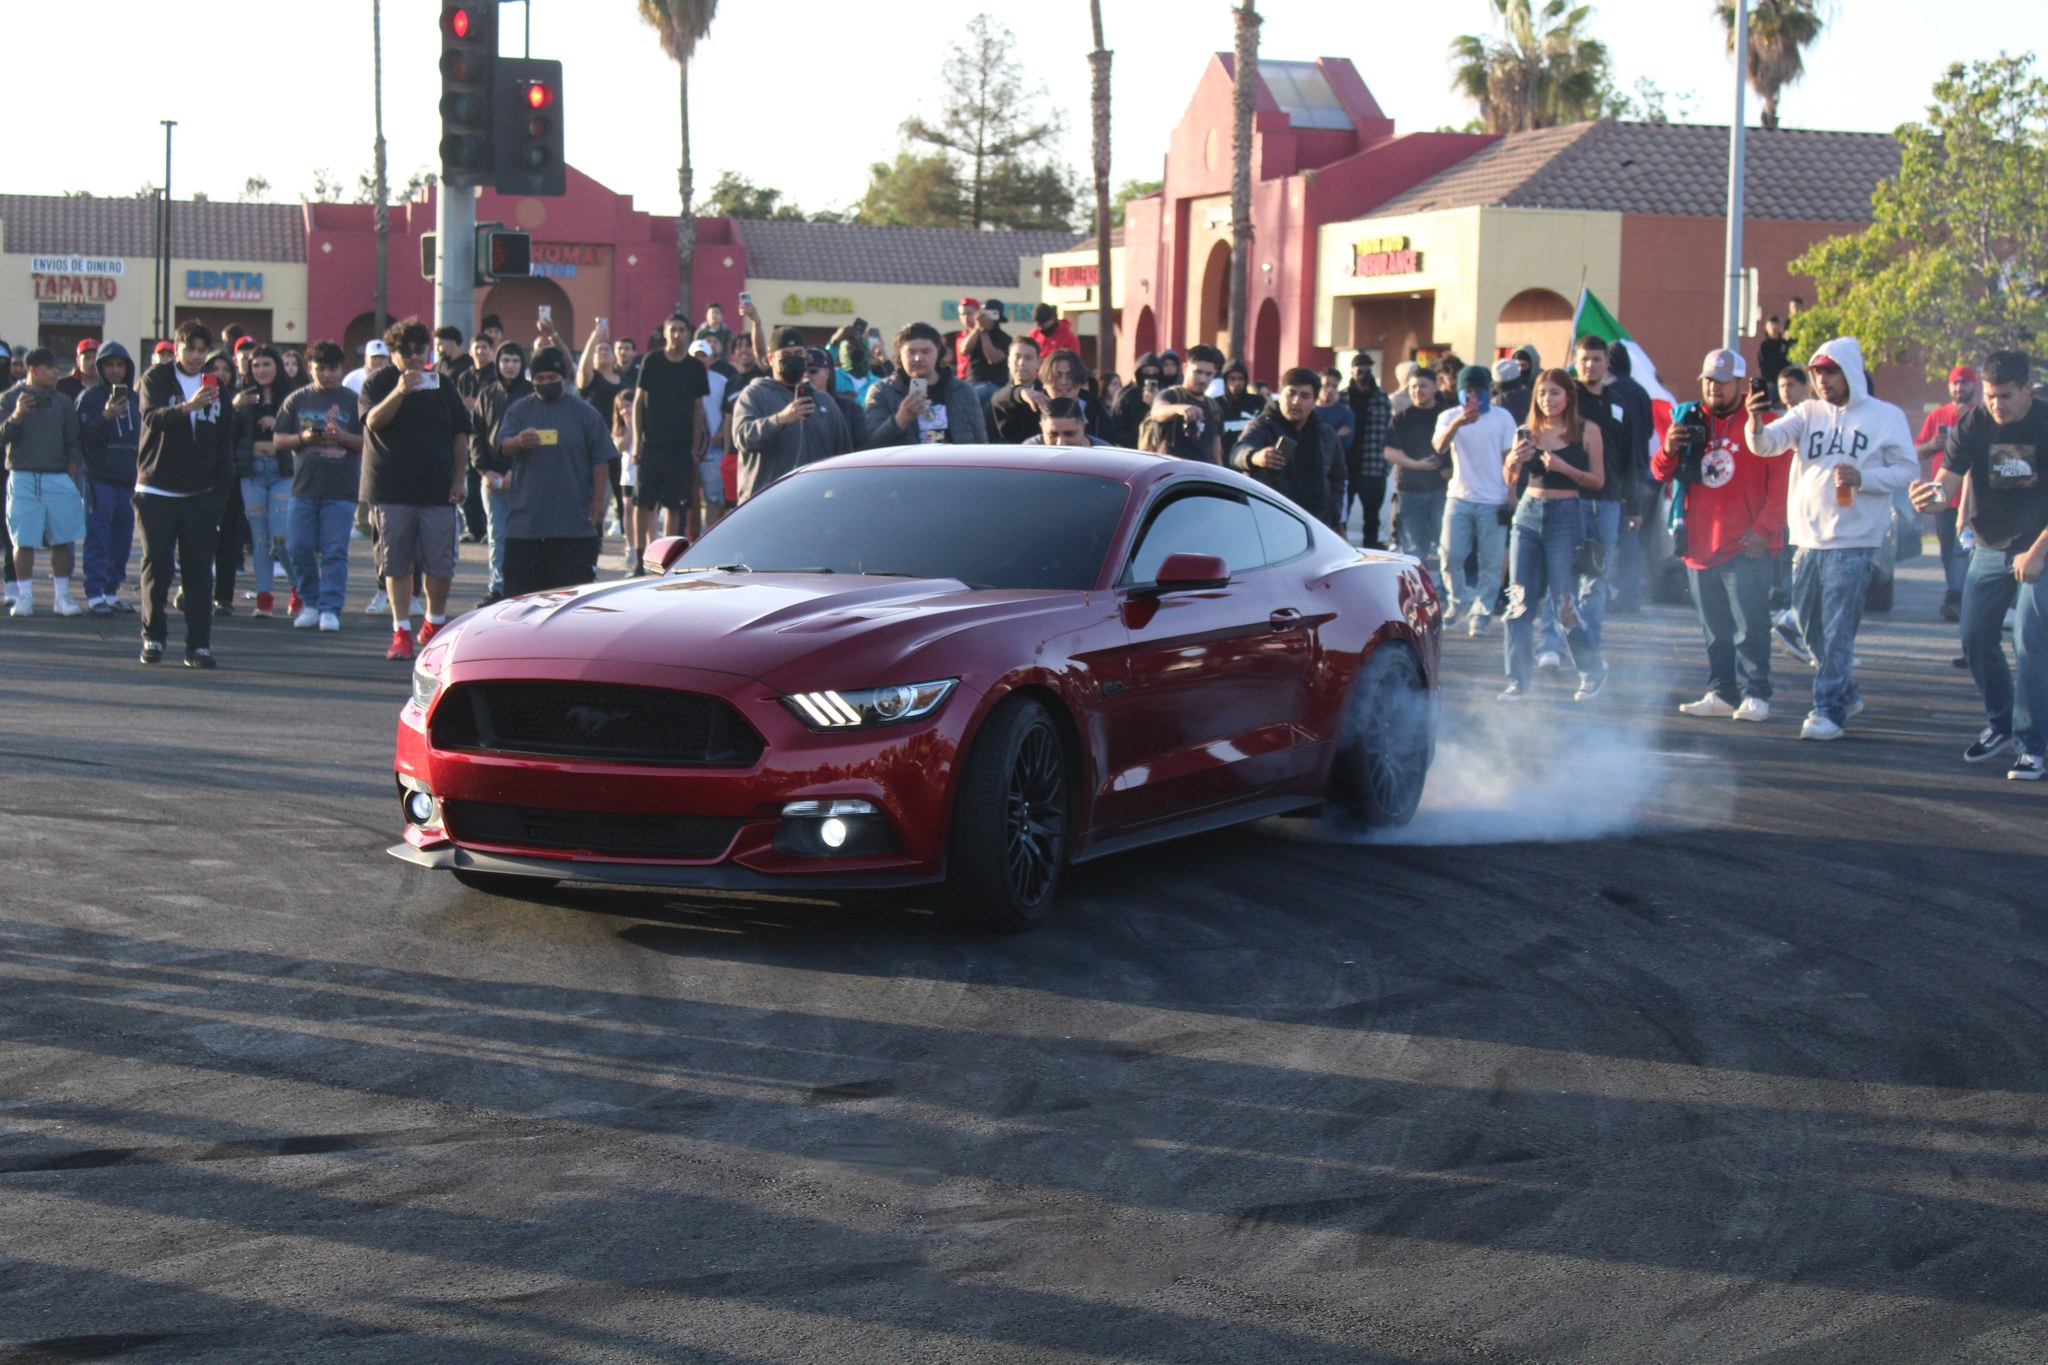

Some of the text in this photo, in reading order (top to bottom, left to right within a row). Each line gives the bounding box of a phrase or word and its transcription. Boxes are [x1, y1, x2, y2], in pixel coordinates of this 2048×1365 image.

[531, 243, 607, 265] ROMAT
[33, 257, 122, 273] ENVIOS DE DINERO
[529, 262, 577, 279] ATER
[31, 272, 117, 302] TAPATIO
[187, 270, 263, 290] EDITH
[187, 288, 262, 300] BEAUTY SALON
[806, 295, 854, 313] PIZZA
[1807, 427, 1868, 460] GAP
